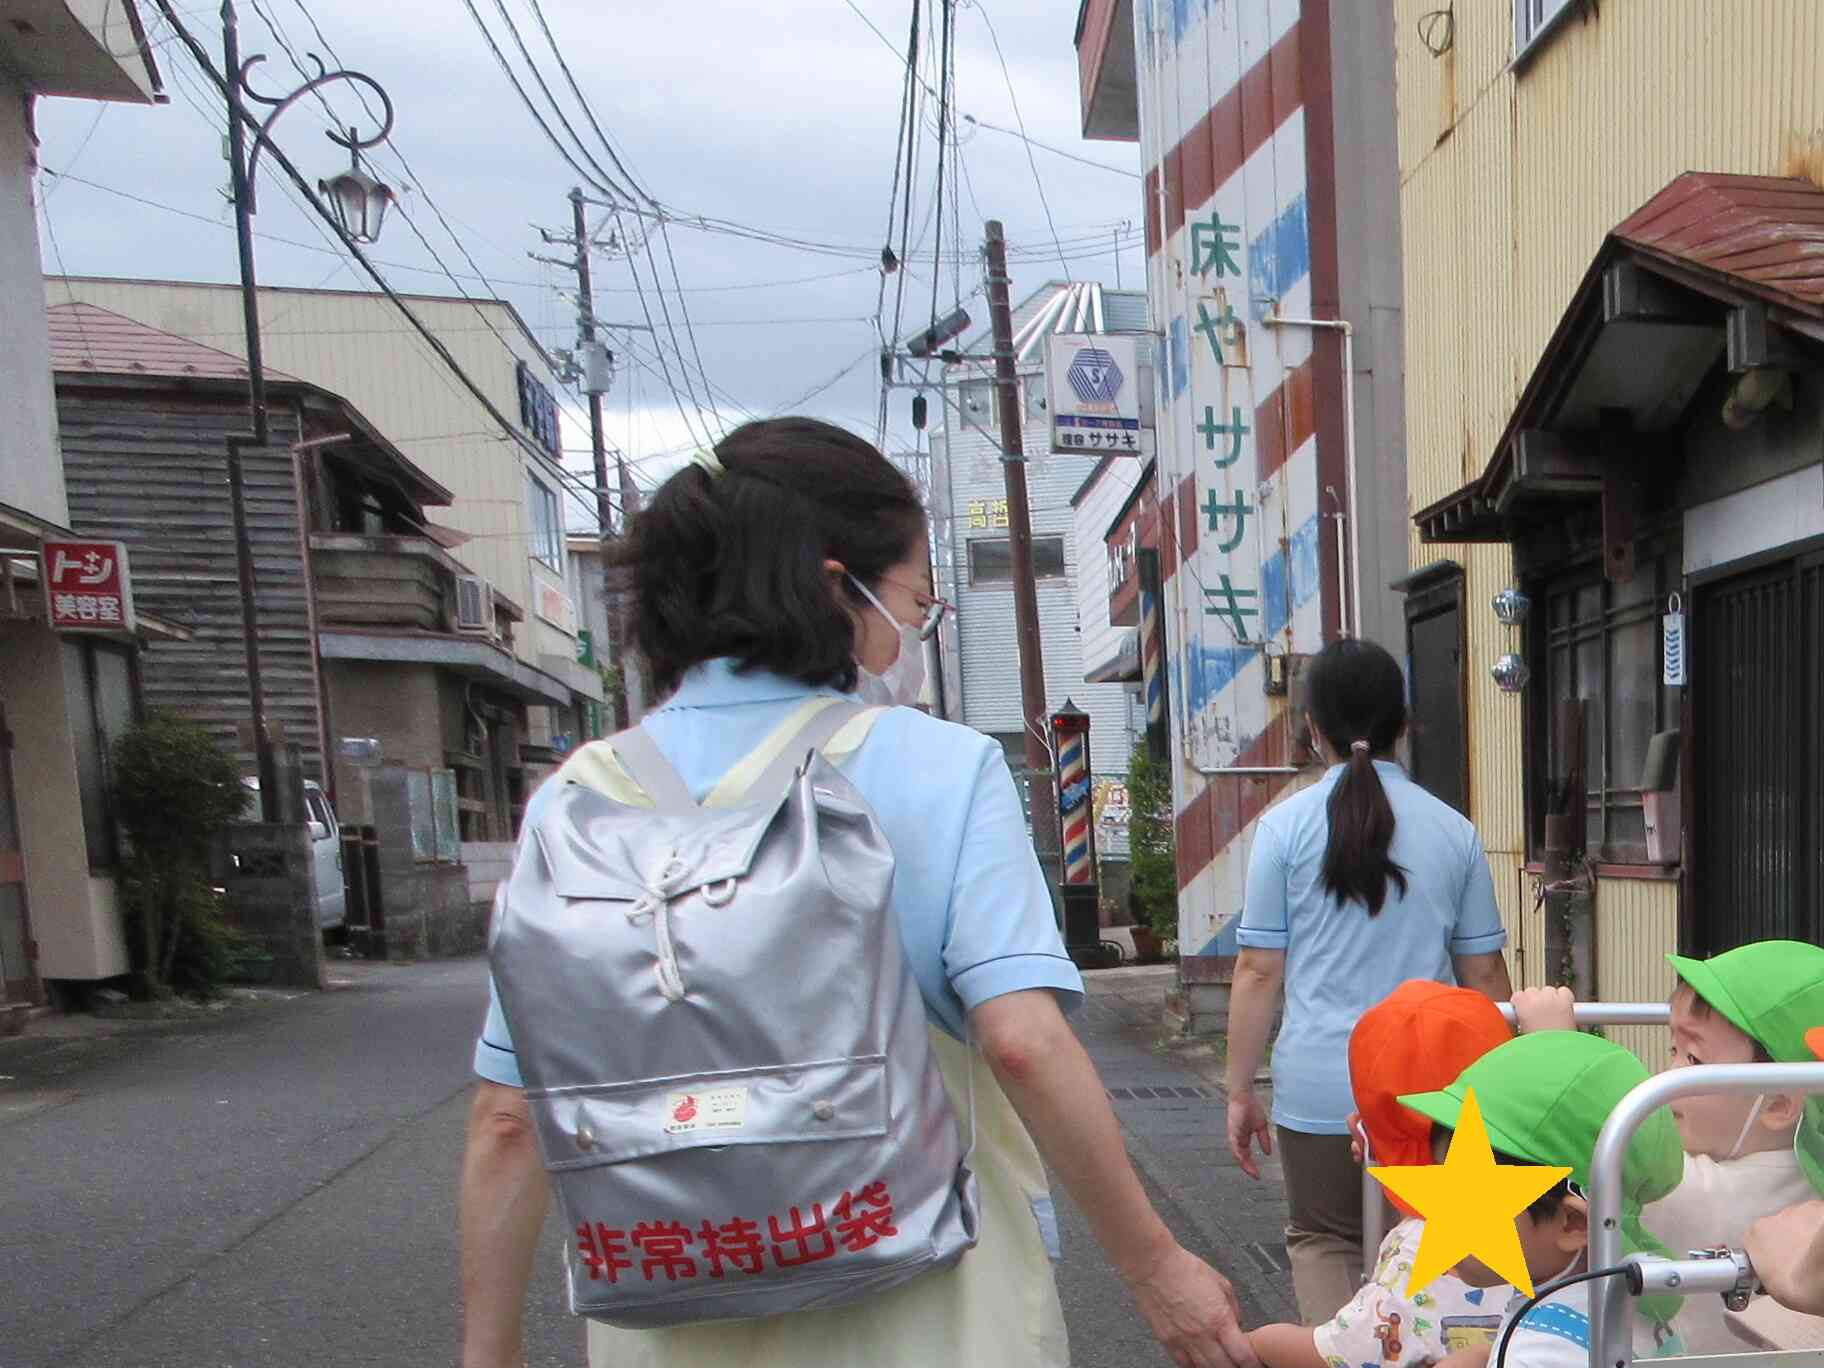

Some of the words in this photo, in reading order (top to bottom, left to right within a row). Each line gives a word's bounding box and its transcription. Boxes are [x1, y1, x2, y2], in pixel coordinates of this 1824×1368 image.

[55, 593, 121, 621] 美容室
[576, 1181, 898, 1283] 非常持出袋
